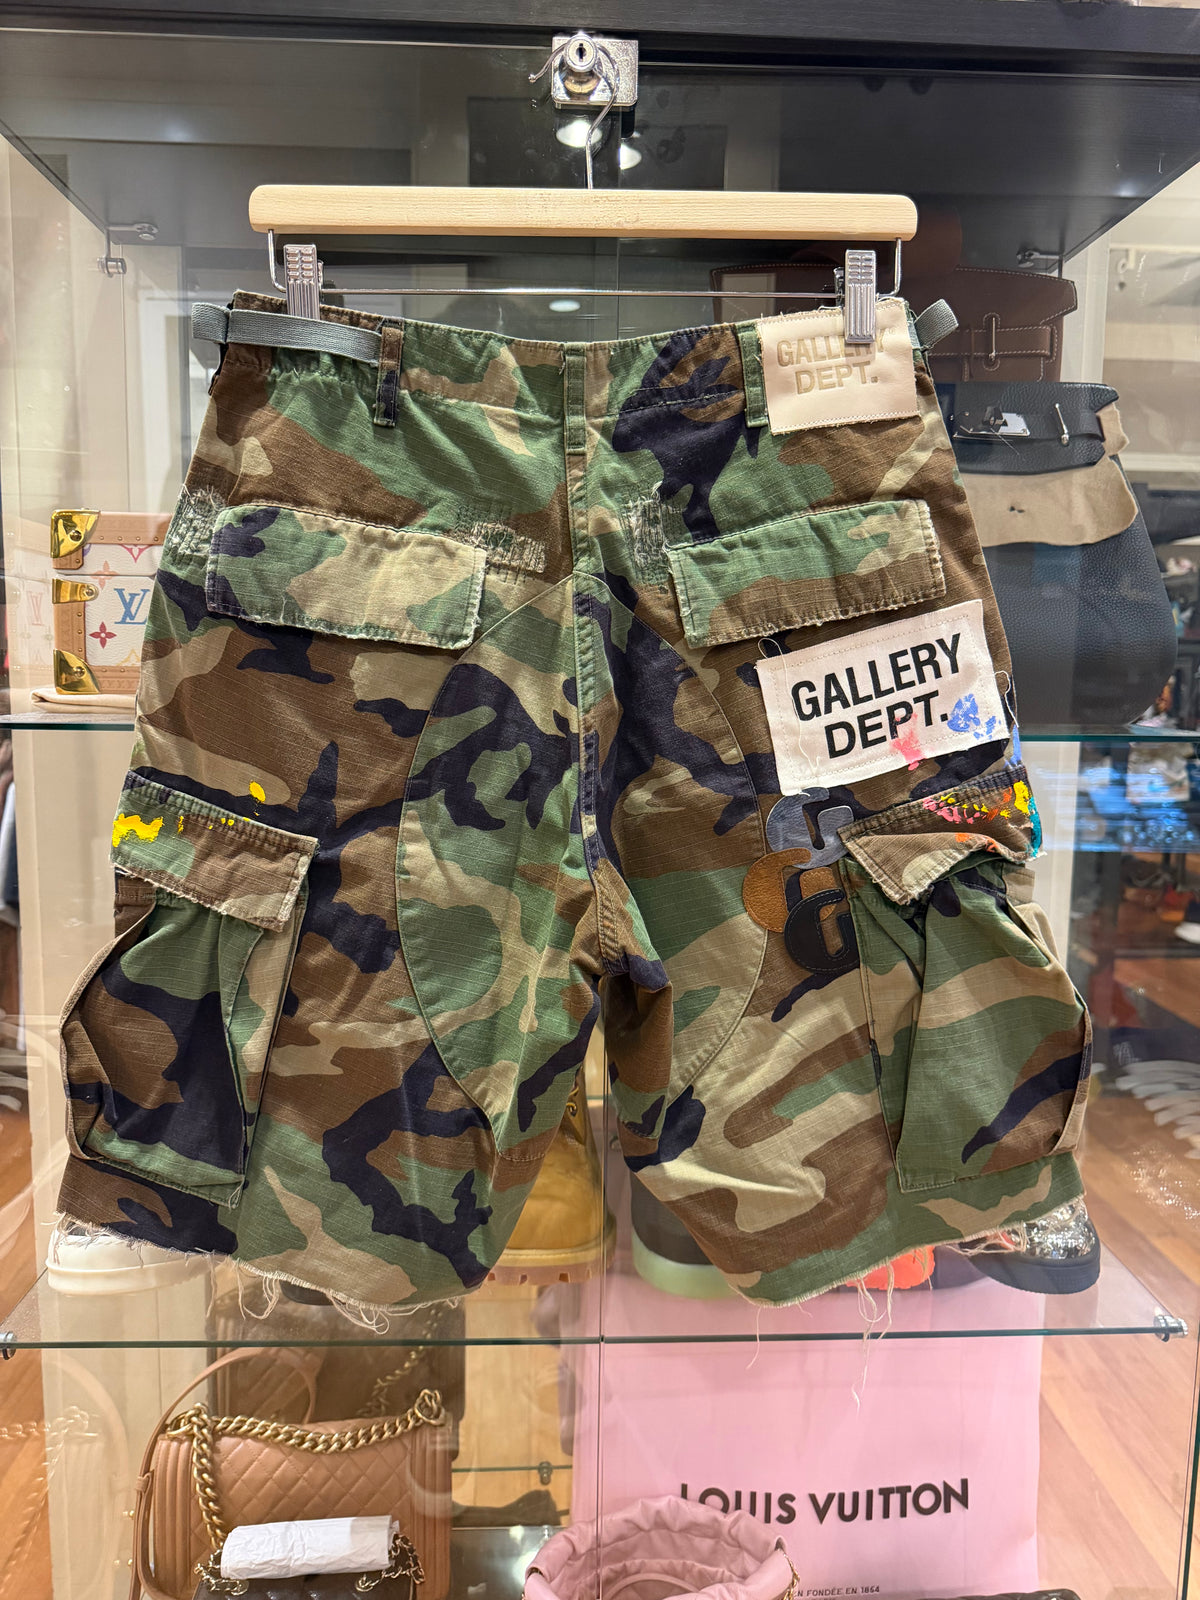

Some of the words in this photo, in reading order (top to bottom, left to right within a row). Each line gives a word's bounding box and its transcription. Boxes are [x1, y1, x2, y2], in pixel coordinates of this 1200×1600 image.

[795, 361, 879, 394] DEPT.
[791, 633, 961, 722] GALLERY
[824, 690, 949, 759] DEPT.
[808, 1478, 969, 1525] VUITTON
[845, 1587, 858, 1595] EN
